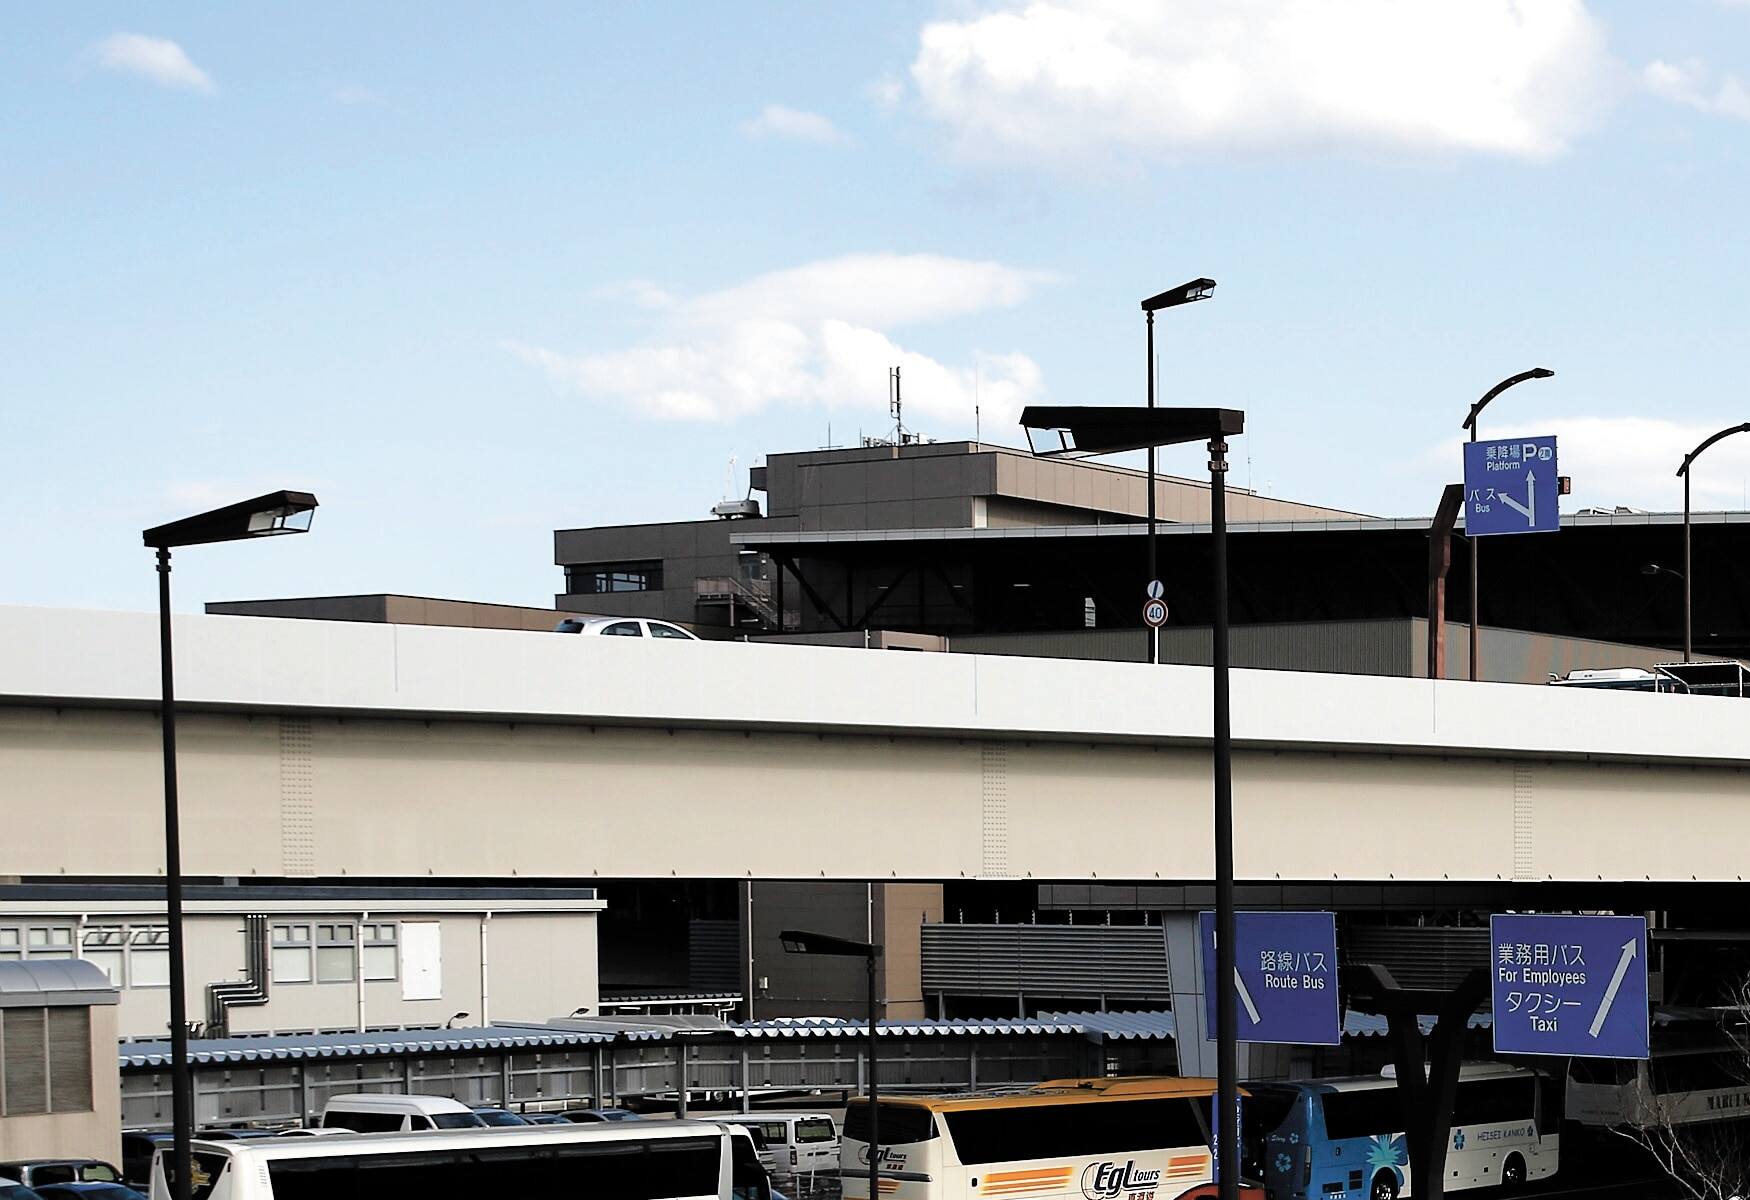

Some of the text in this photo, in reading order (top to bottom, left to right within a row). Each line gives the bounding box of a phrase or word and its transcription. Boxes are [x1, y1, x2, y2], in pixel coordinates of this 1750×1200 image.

[1486, 444, 1520, 460] 乗降場
[1486, 461, 1520, 471] Platform
[1475, 503, 1490, 513] Bus
[1149, 607, 1162, 618] 40
[1260, 950, 1328, 973] 路線バス
[1498, 943, 1586, 966] 業務用バス
[1265, 973, 1325, 990] Route Bus
[1498, 967, 1586, 987] For Employees
[1505, 992, 1582, 1014] タクシー
[1529, 1016, 1558, 1032] Taxi
[1133, 1169, 1160, 1182] tours
